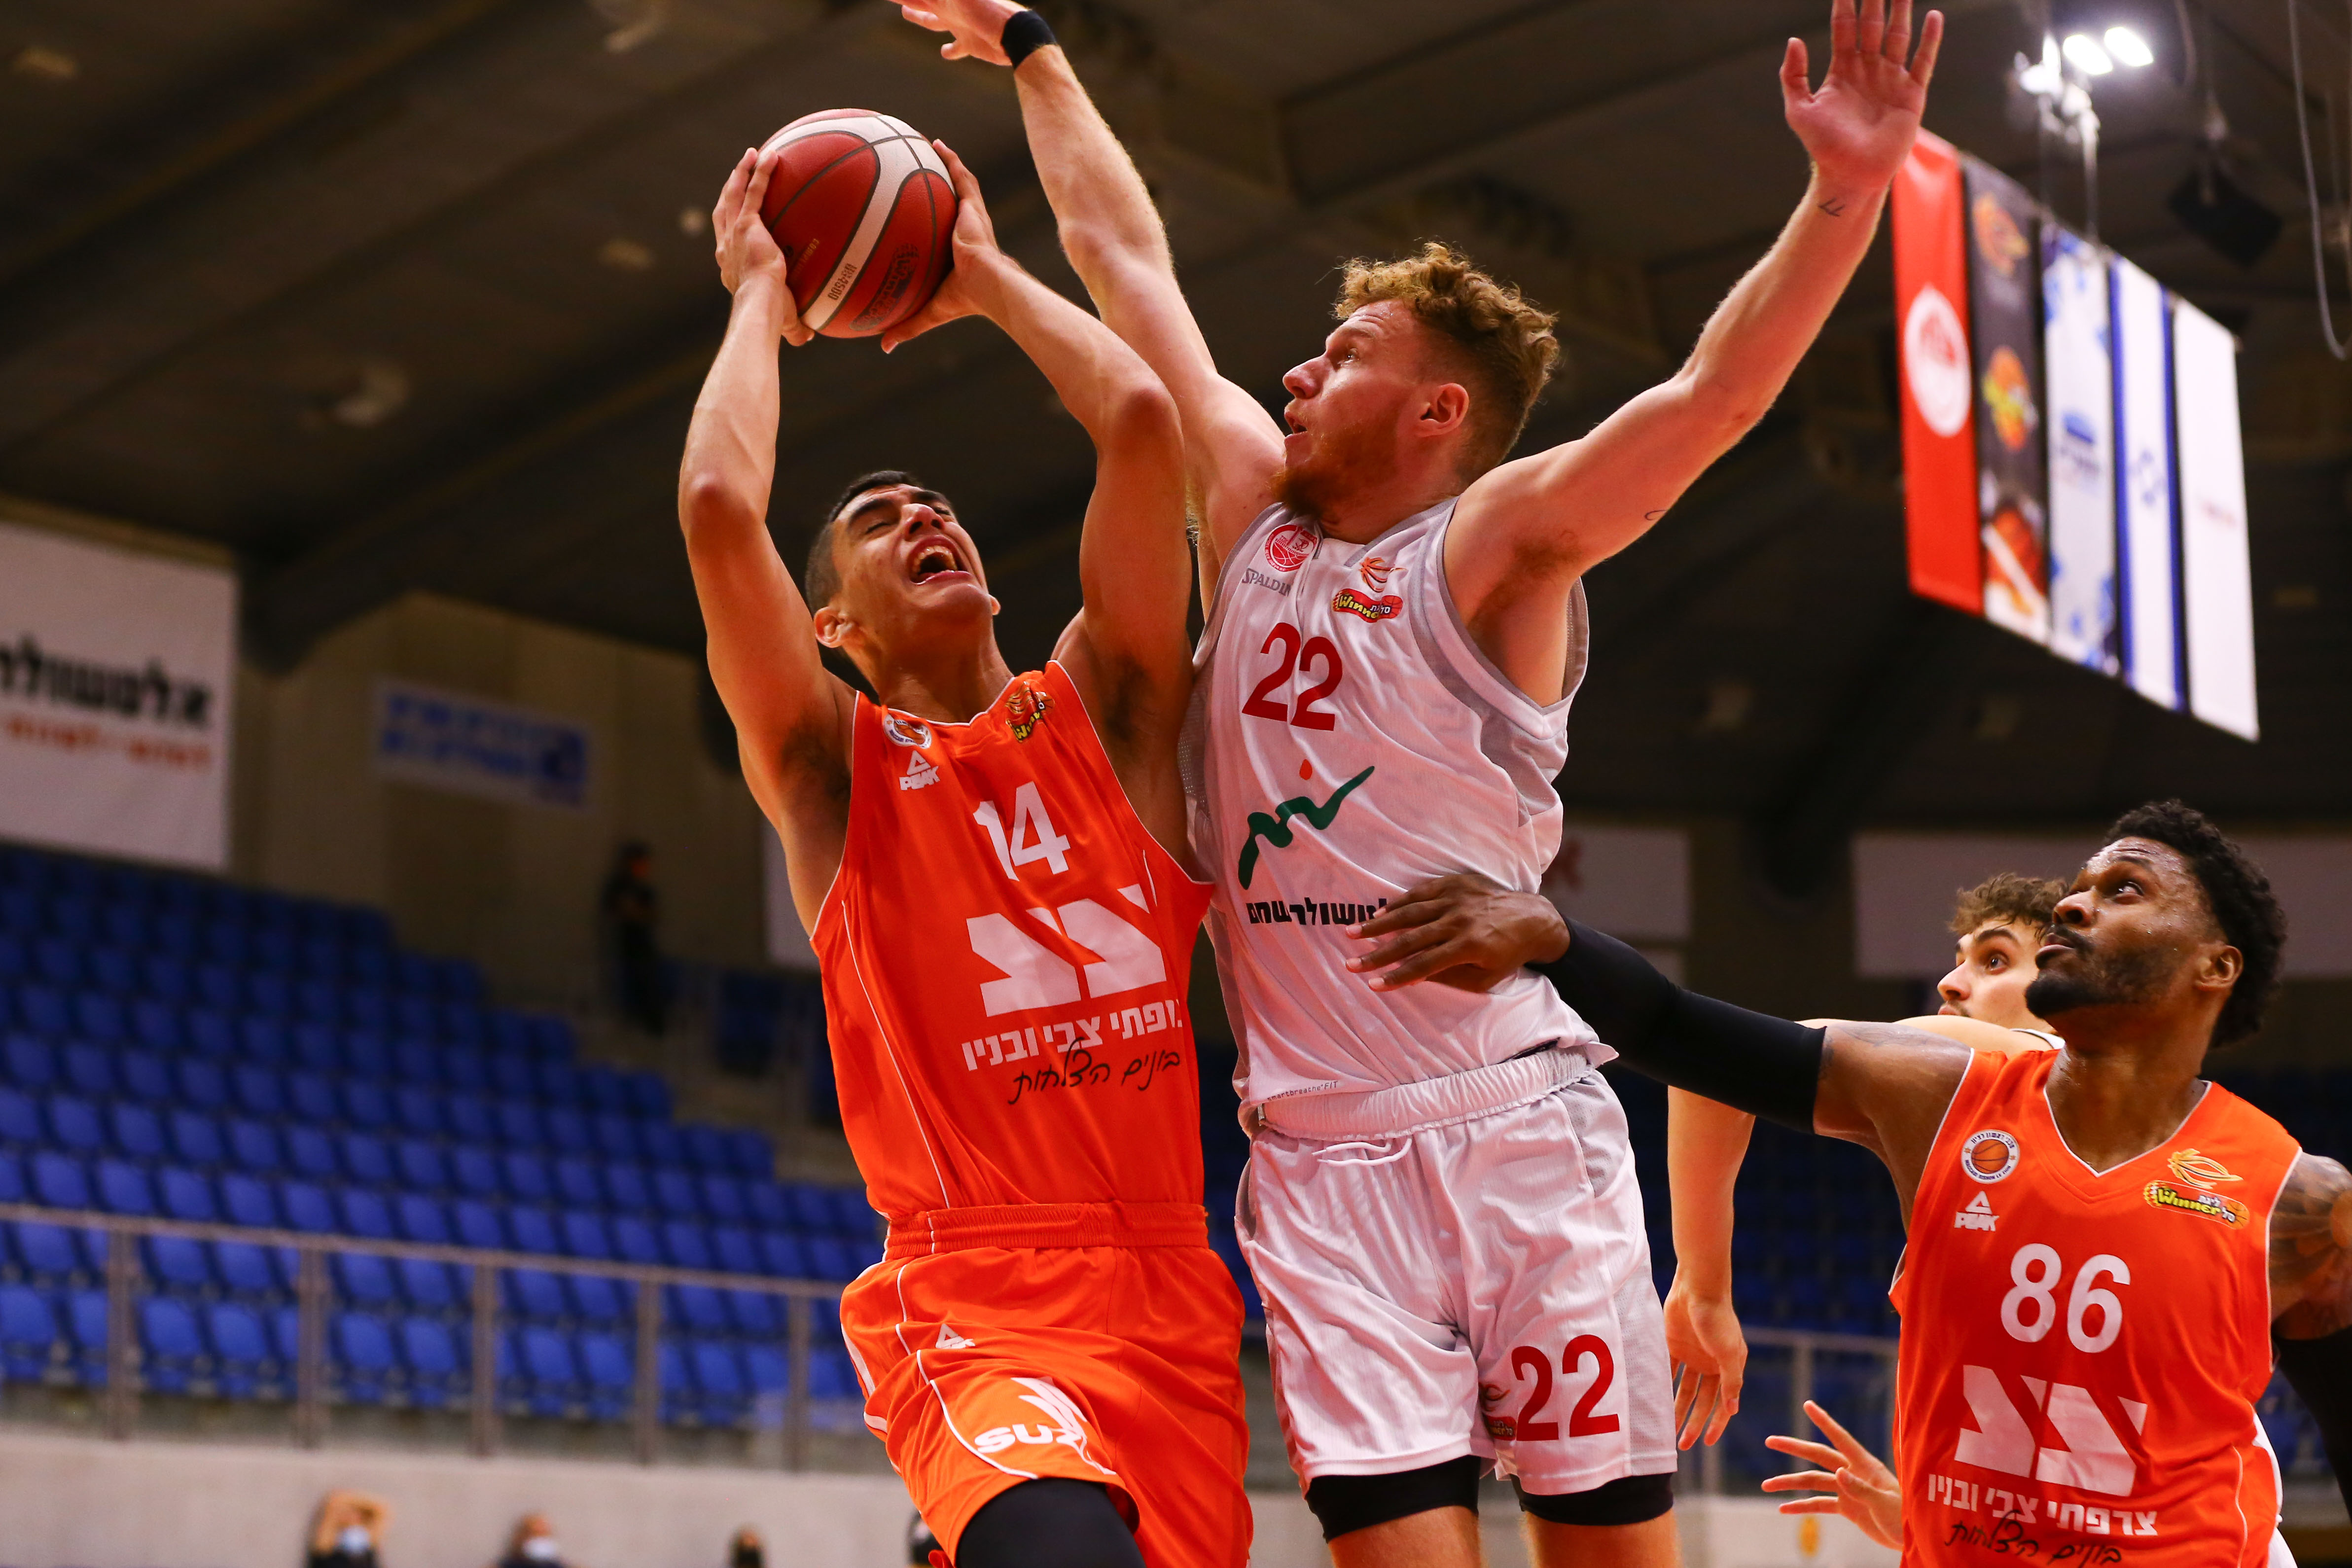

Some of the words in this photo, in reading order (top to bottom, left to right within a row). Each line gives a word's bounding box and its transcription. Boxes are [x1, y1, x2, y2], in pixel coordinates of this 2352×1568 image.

[1242, 568, 1291, 597] SPALDIN
[1338, 595, 1379, 619] Winne
[1242, 622, 1342, 731] 22
[899, 766, 940, 790] PEAK
[972, 781, 1071, 881] 14
[962, 1027, 1039, 1071] ובניו
[1043, 1016, 1103, 1053] צבי
[1007, 1036, 1111, 1105] הצלחות
[1122, 1049, 1180, 1091] בונים
[2157, 1188, 2221, 1215] Winner
[1954, 1212, 1999, 1232] PEAK
[2001, 1243, 2131, 1353] 86
[1511, 1334, 1620, 1442] 22
[1928, 1474, 1979, 1512] ובניו
[1985, 1488, 2039, 1524] צבי
[2047, 1500, 2158, 1536] צרפתי
